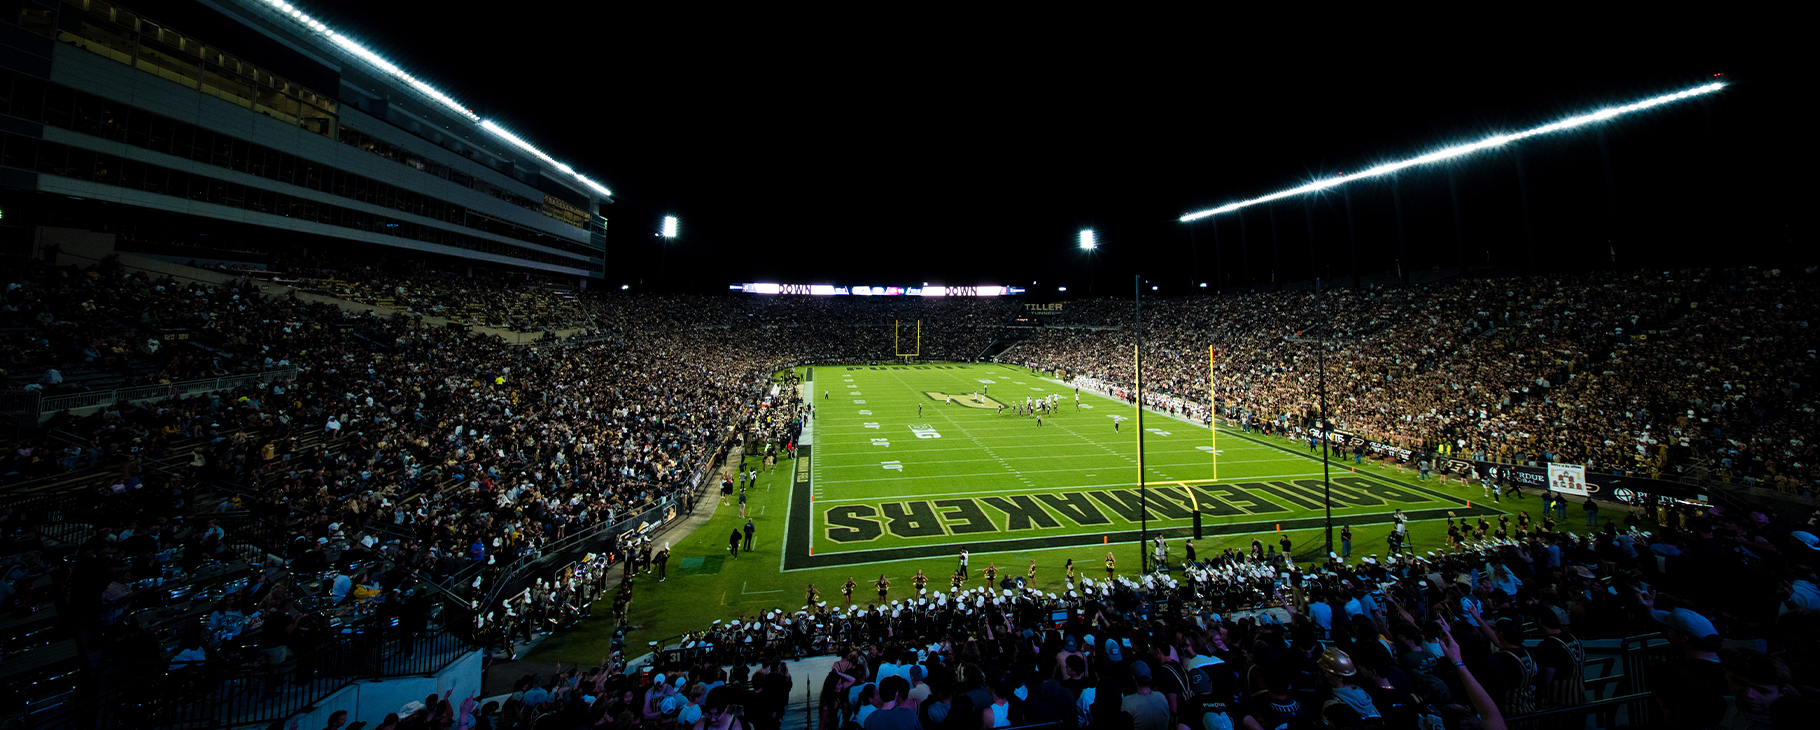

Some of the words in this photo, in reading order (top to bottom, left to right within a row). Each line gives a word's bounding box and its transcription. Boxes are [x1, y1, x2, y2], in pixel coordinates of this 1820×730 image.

[779, 284, 810, 295] DOWN
[945, 286, 976, 297] DOWN
[1024, 303, 1063, 311] TILLER
[870, 438, 890, 447] 20
[881, 460, 904, 471] 10
[824, 476, 1440, 544] BOILERMAKERS
[1158, 602, 1169, 613] 32
[669, 652, 681, 663] 31
